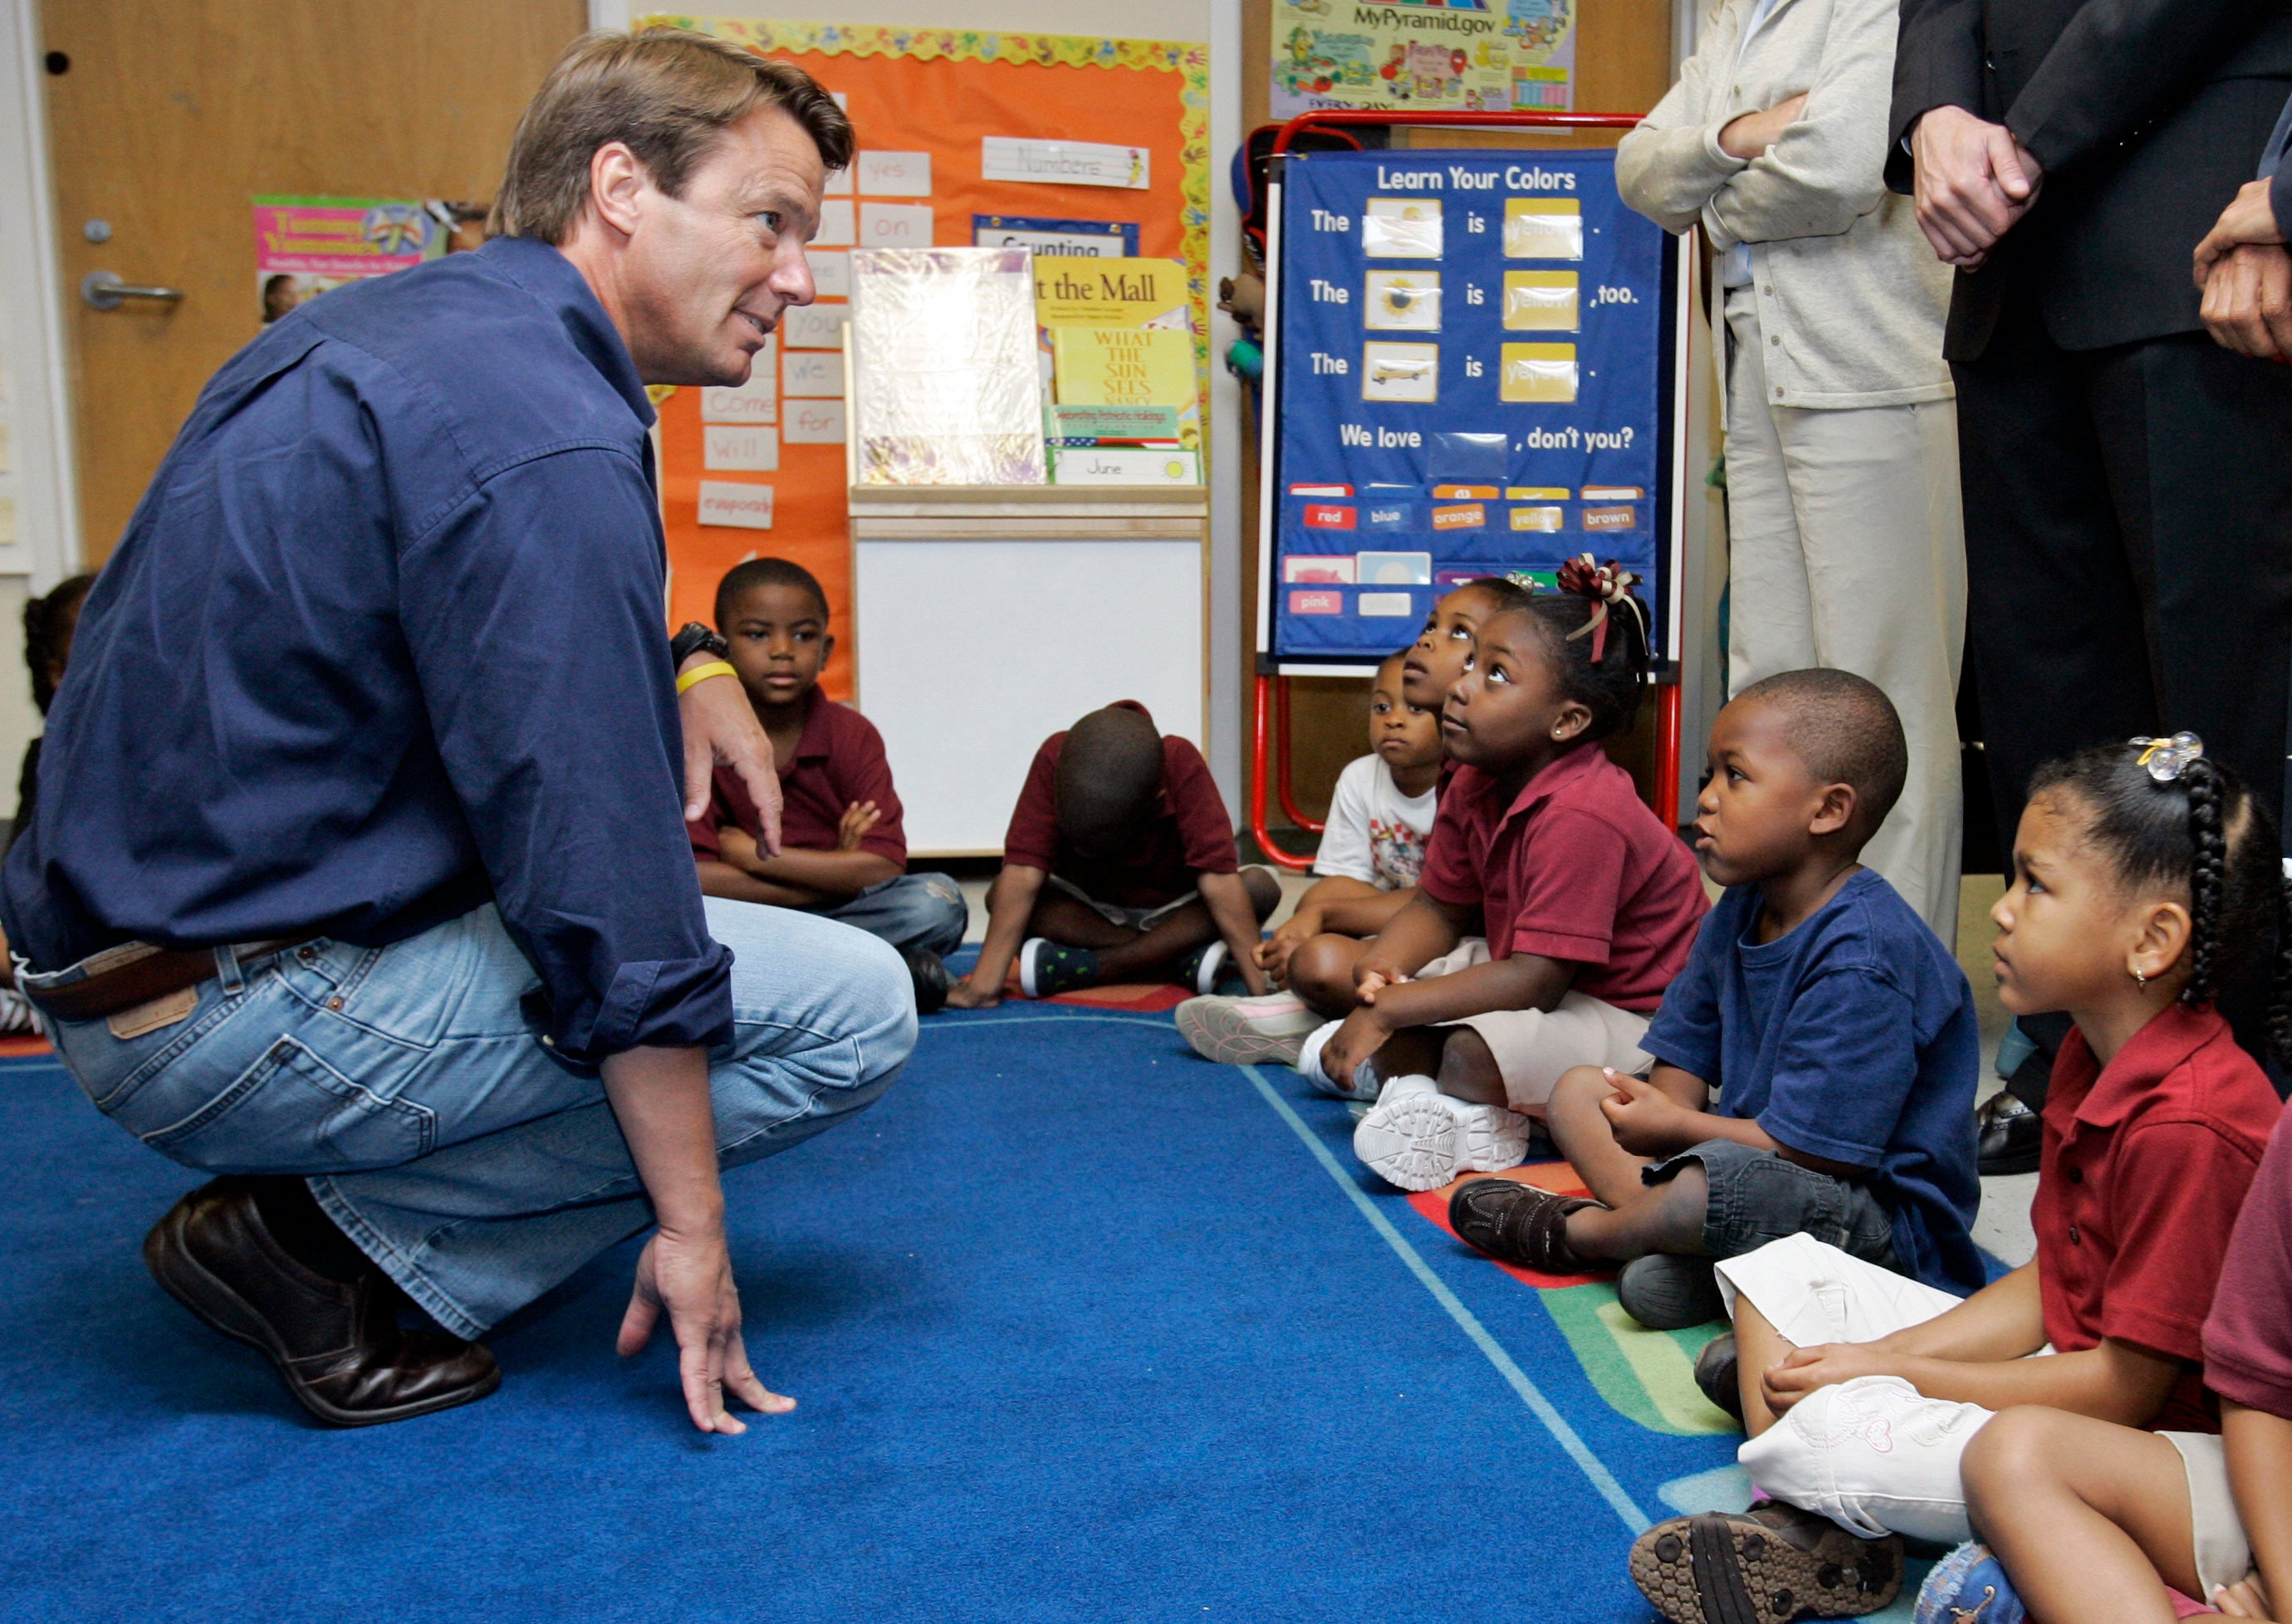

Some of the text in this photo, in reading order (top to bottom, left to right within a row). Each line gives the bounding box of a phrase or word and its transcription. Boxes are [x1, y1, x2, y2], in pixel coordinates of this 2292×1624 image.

[1354, 7, 1496, 36] MyPyramid.gov
[1018, 145, 1101, 176] Numbers
[868, 163, 904, 182] yes
[1378, 166, 1575, 190] Learn Your Colors
[874, 217, 909, 235] on
[1311, 209, 1350, 232] The
[1467, 212, 1485, 233] is
[1055, 273, 1093, 300] the
[1100, 273, 1157, 301] Mall
[1310, 280, 1349, 304] The
[1467, 283, 1484, 305] is
[1094, 331, 1154, 346] WHAT
[1106, 348, 1141, 362] THE
[1105, 364, 1147, 379] SUN
[1310, 353, 1349, 375] The
[1466, 355, 1482, 377] is
[1104, 380, 1152, 395] SEES
[799, 411, 835, 431] for
[1340, 424, 1373, 447] We
[1378, 425, 1422, 448] love
[1584, 426, 1634, 453] you?
[1087, 458, 1121, 475] June
[1317, 511, 1342, 523] red
[1371, 510, 1401, 523] blue
[1434, 510, 1482, 526] orange
[1515, 510, 1556, 526] yellow
[1587, 511, 1629, 525] brown
[1300, 595, 1330, 609] pink
